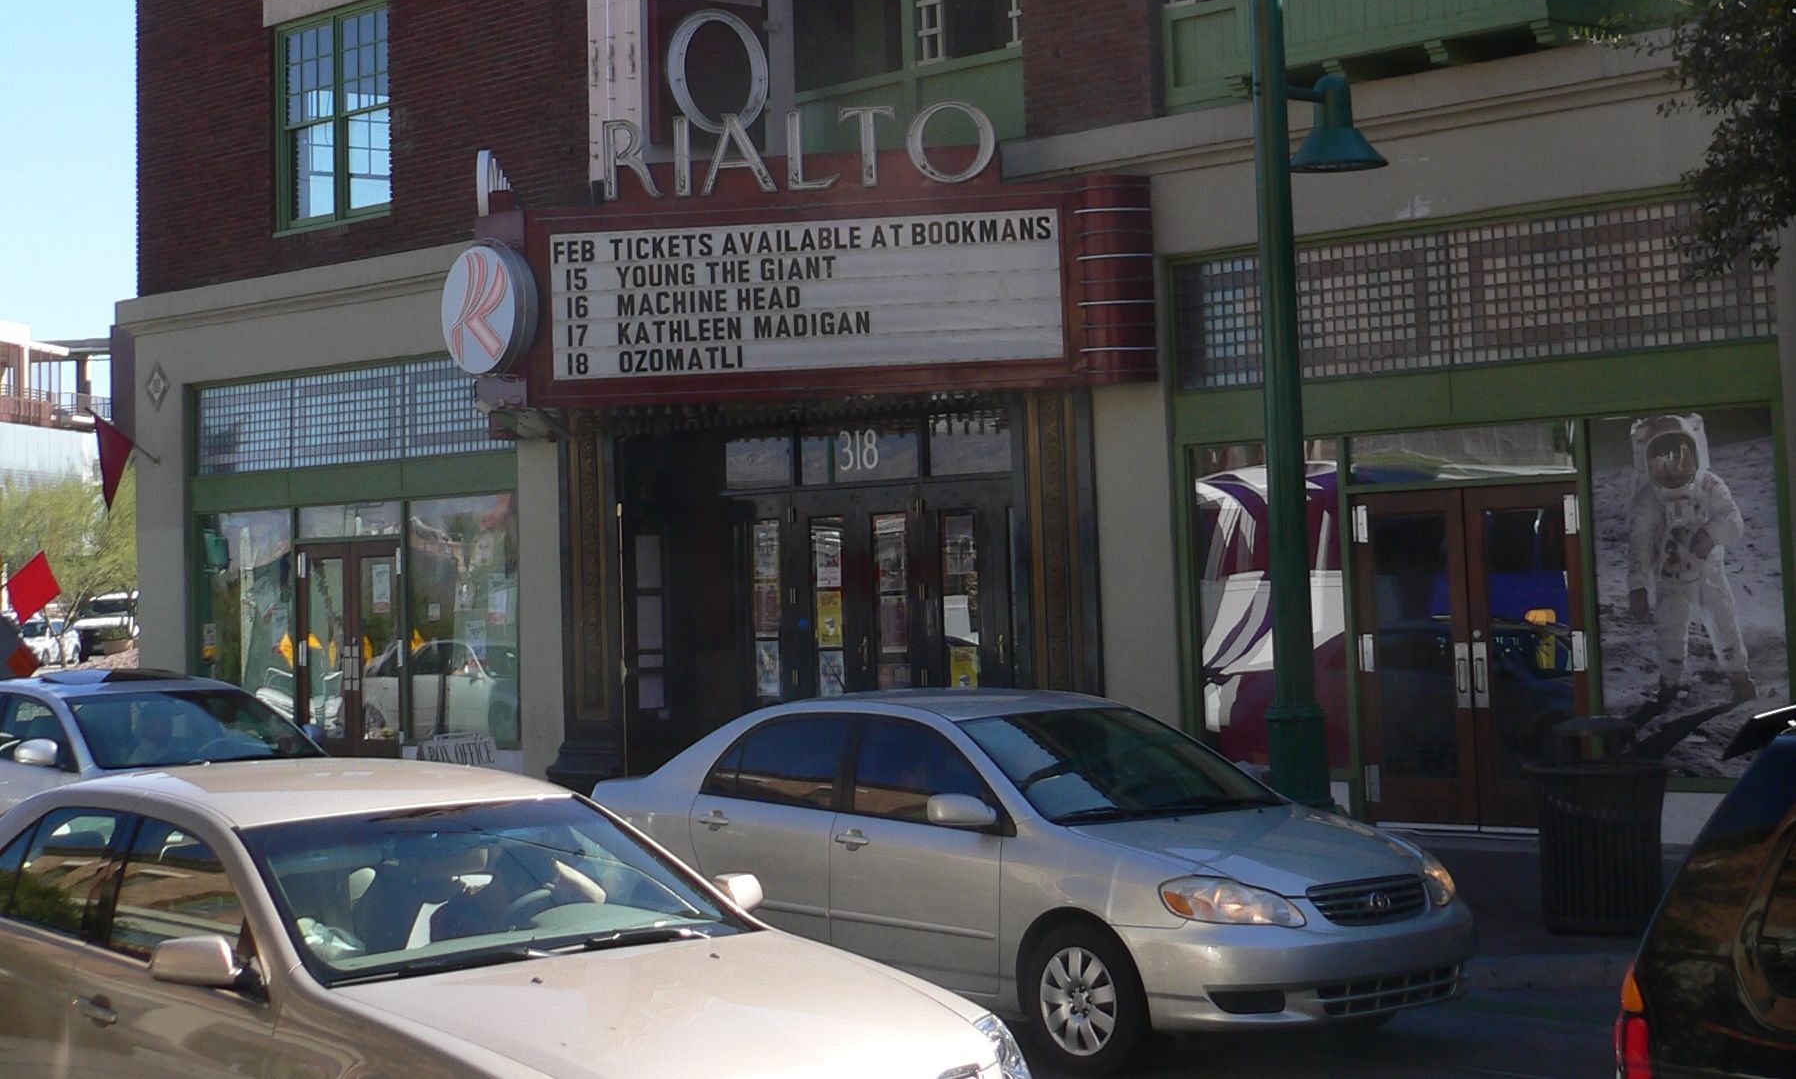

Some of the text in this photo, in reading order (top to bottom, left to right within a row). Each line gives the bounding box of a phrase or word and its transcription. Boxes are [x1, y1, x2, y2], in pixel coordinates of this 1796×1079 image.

[603, 100, 997, 202] RIALTO
[553, 216, 1052, 264] FEB TICKETS AVAILABLE AT BOOKMANS
[566, 255, 836, 291] 15 YOUNG THE GIANT
[566, 285, 801, 319] 16 MACHINE HEAD
[567, 311, 870, 347] 17 KATHLEEN MADIGAN
[567, 345, 743, 375] 18 OZOMATLI
[839, 428, 879, 471] 318
[454, 740, 495, 765] OFFICE
